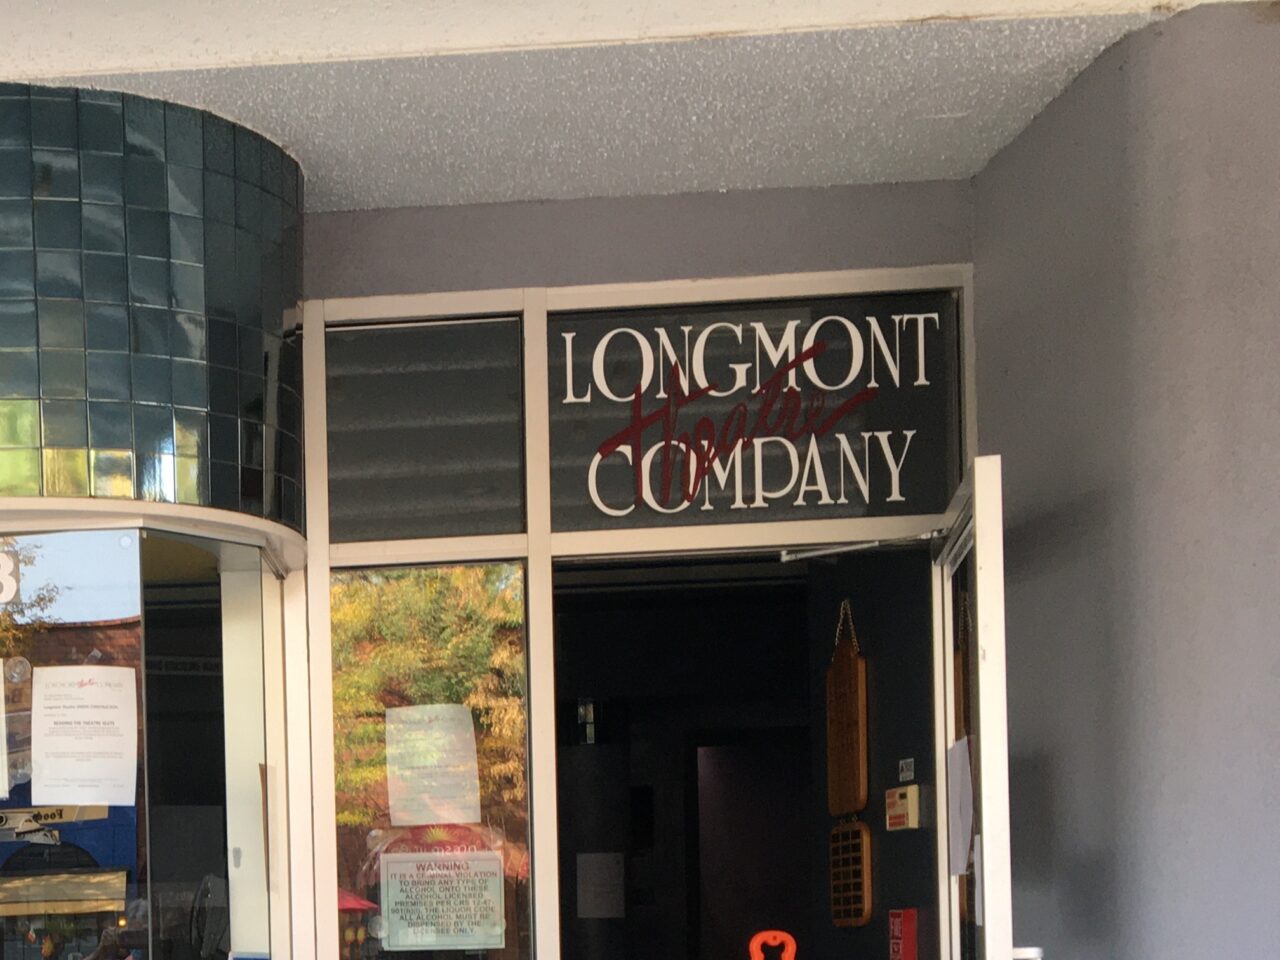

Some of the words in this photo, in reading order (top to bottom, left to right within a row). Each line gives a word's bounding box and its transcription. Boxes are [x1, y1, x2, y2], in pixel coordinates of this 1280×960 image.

[561, 312, 940, 404] LONGMONT
[587, 429, 917, 517] COMPANY
[416, 862, 470, 871] WARNING
